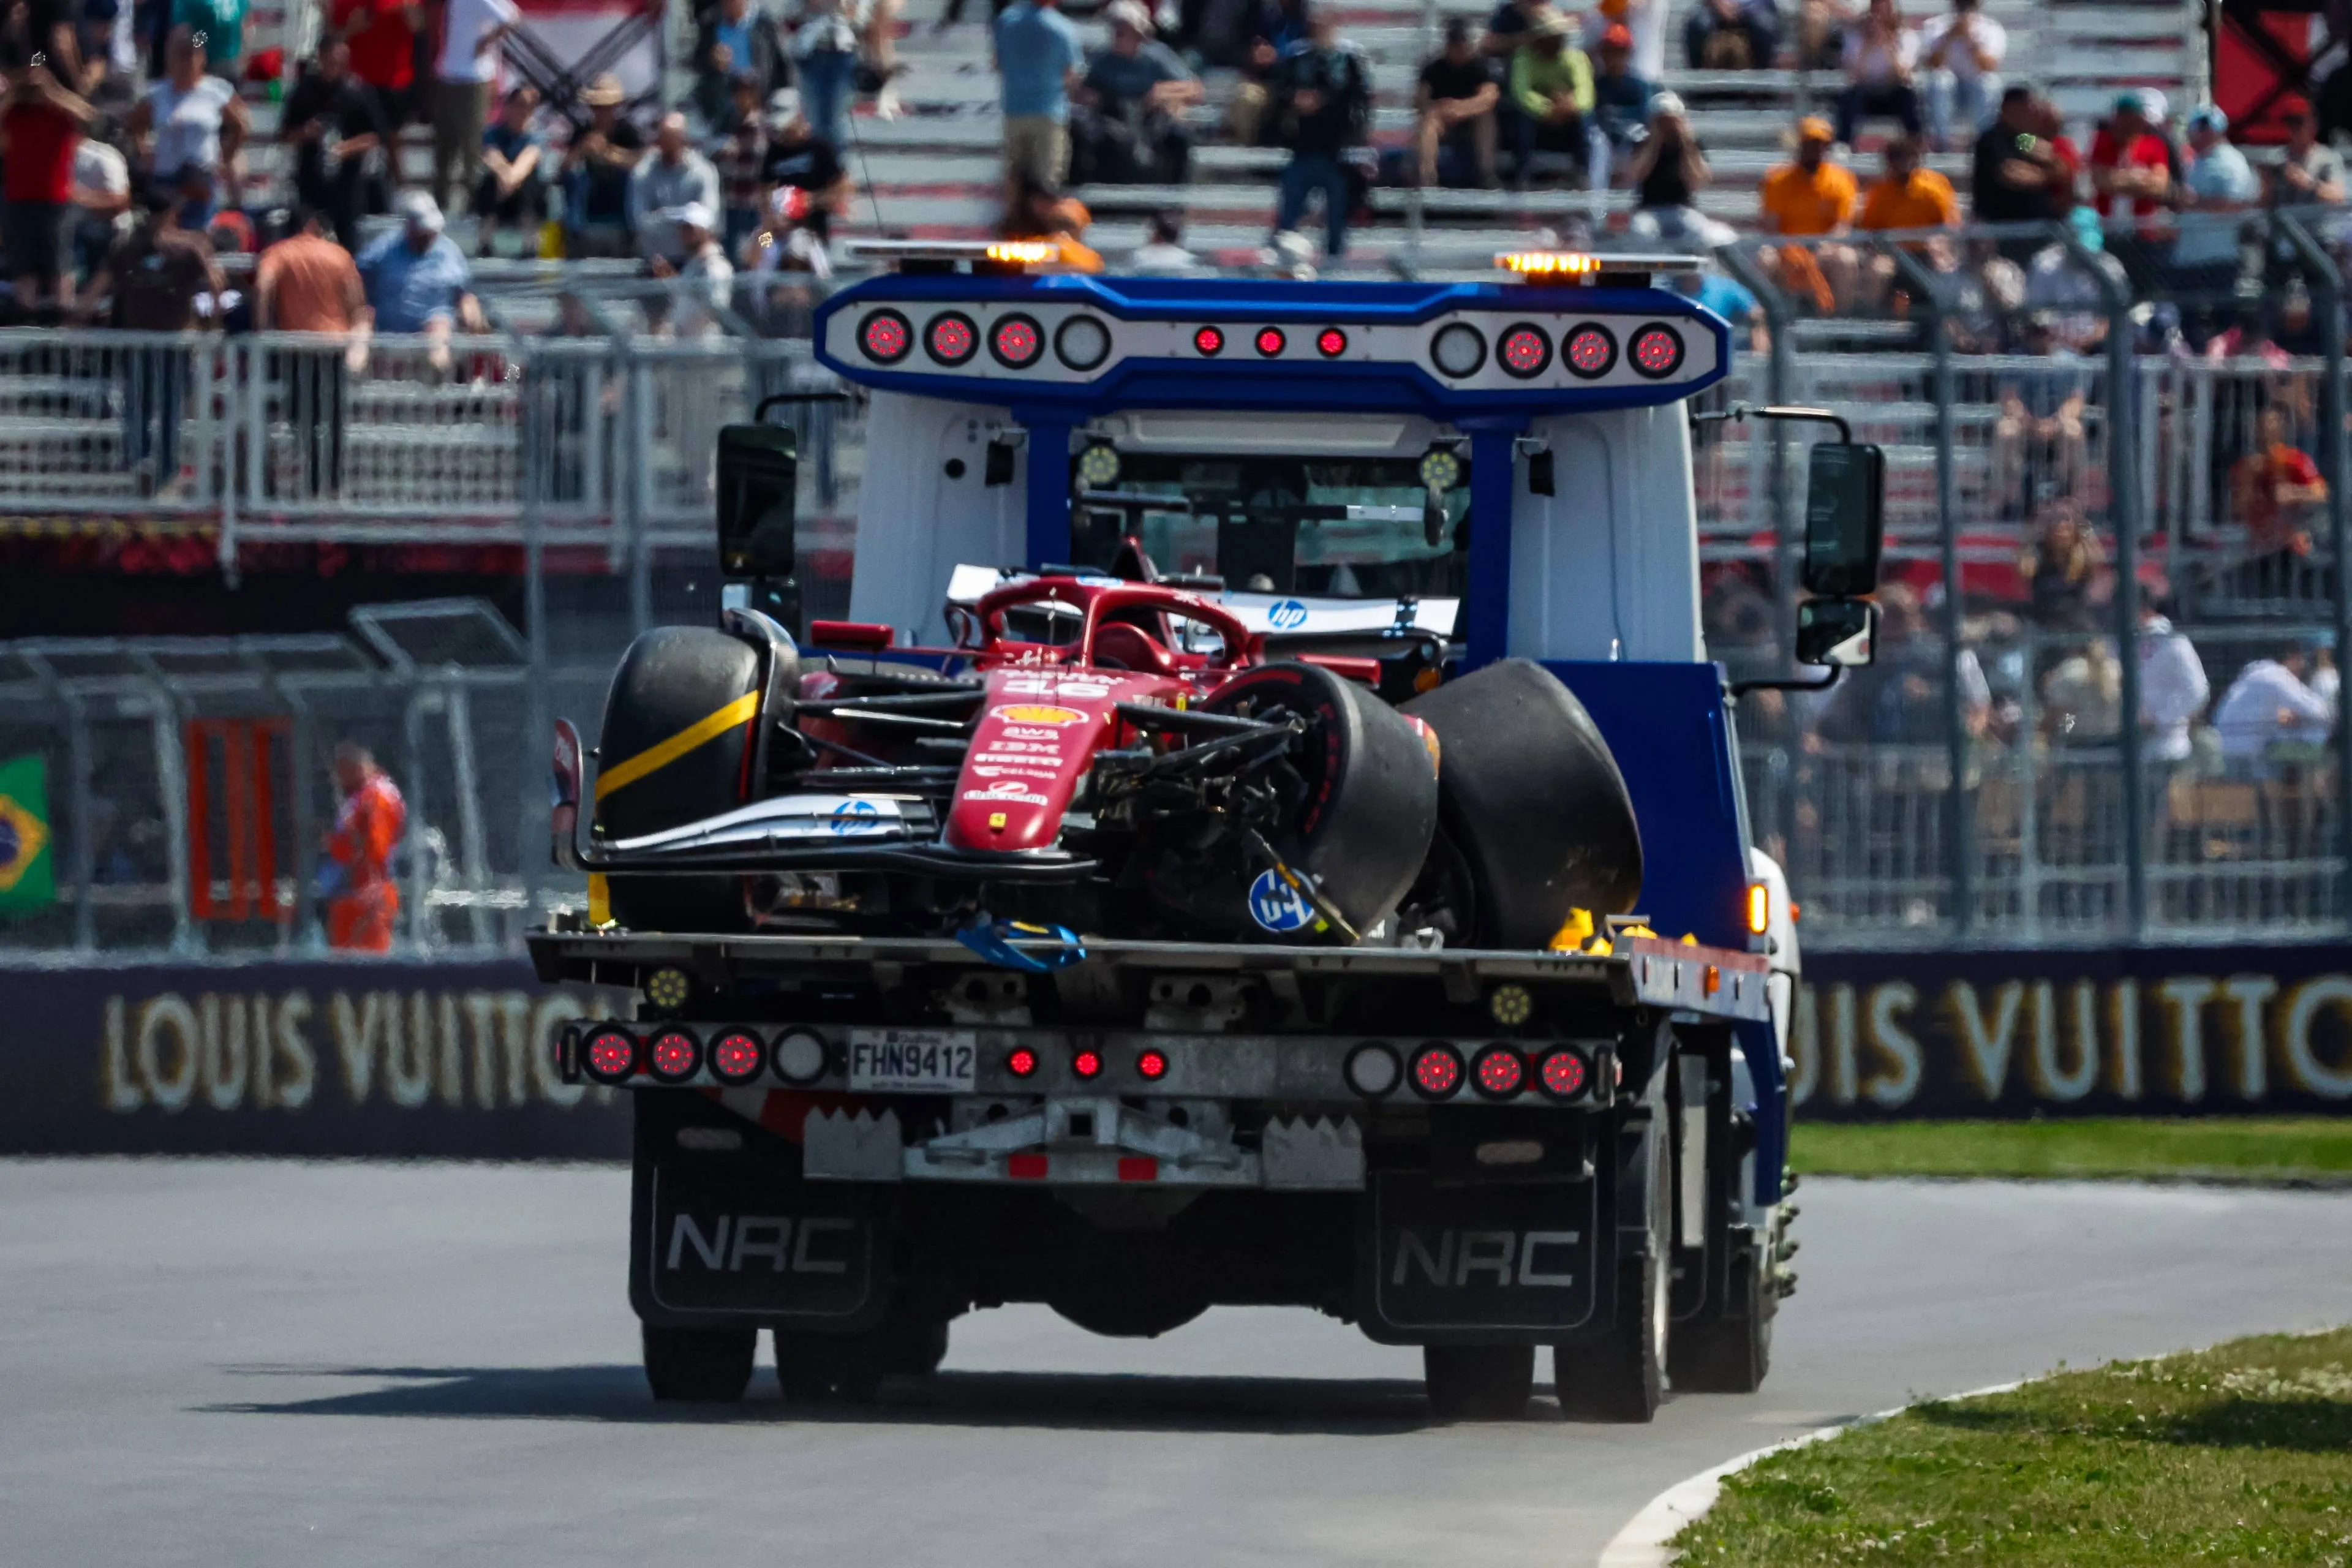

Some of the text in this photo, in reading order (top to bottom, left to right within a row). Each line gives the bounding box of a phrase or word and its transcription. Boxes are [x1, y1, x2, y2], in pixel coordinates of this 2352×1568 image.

[1268, 598, 1307, 631] hp
[105, 989, 614, 1110] LOUIS VUITTO
[854, 1042, 973, 1079] FHN9412
[667, 1213, 858, 1273] NRC
[1392, 1230, 1580, 1286] NRC
